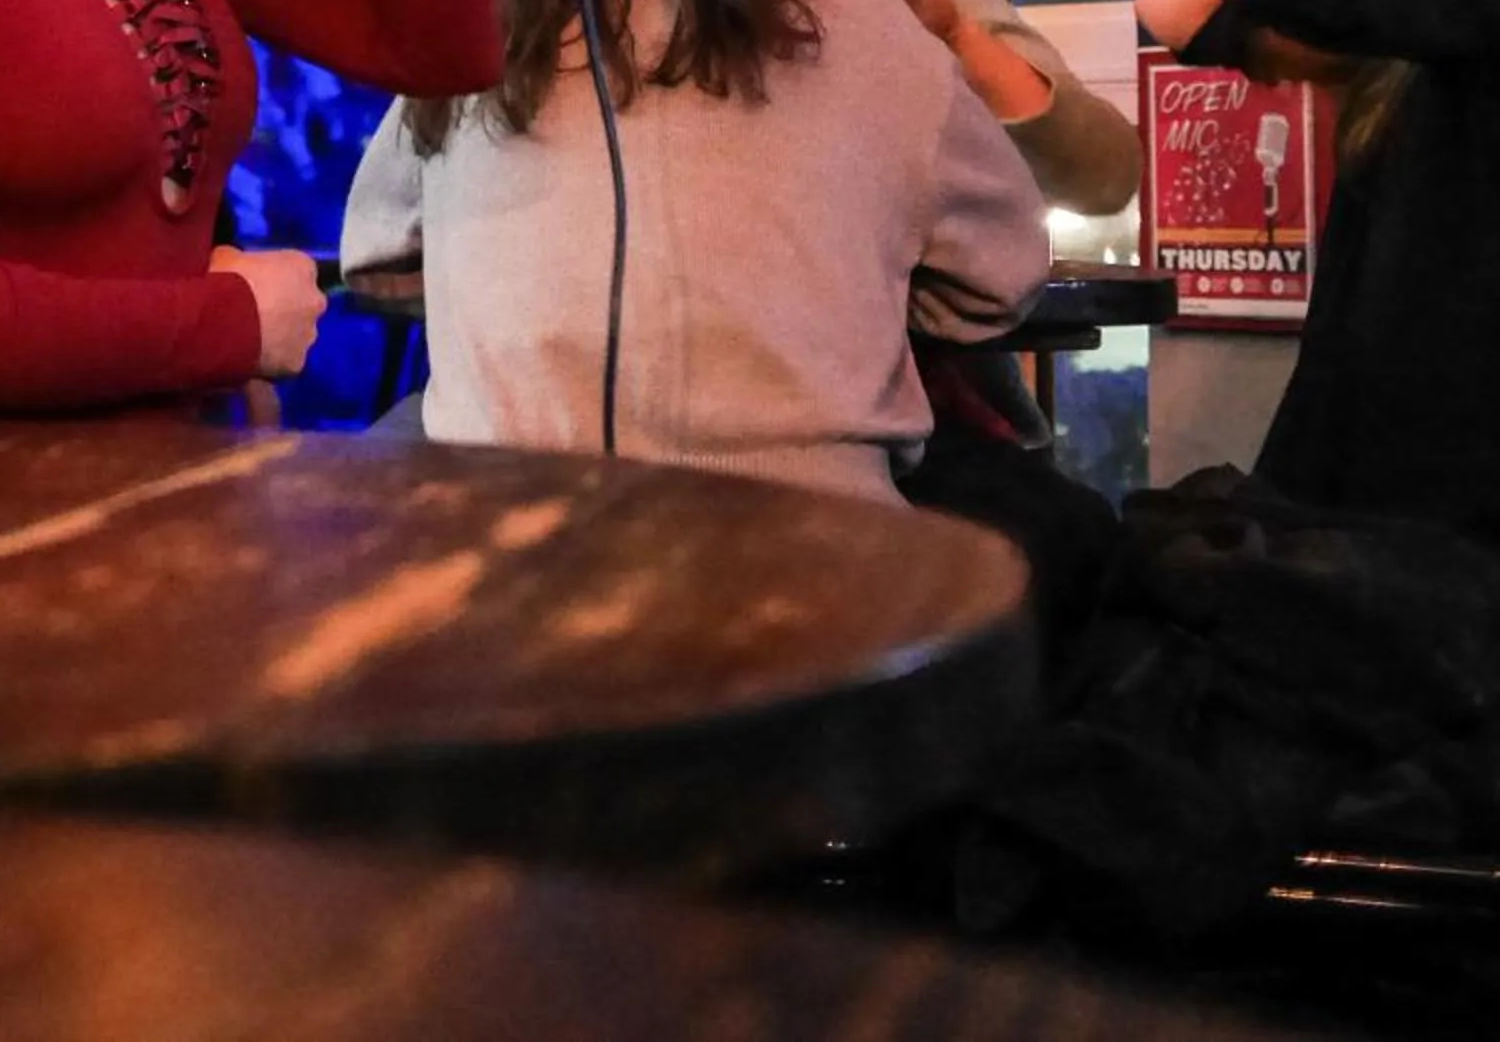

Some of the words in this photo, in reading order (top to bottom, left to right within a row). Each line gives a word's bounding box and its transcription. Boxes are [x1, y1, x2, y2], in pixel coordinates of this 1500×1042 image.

[1160, 79, 1250, 114] OPEN
[1161, 118, 1220, 155] MIC
[1161, 249, 1302, 271] THURSDAY
